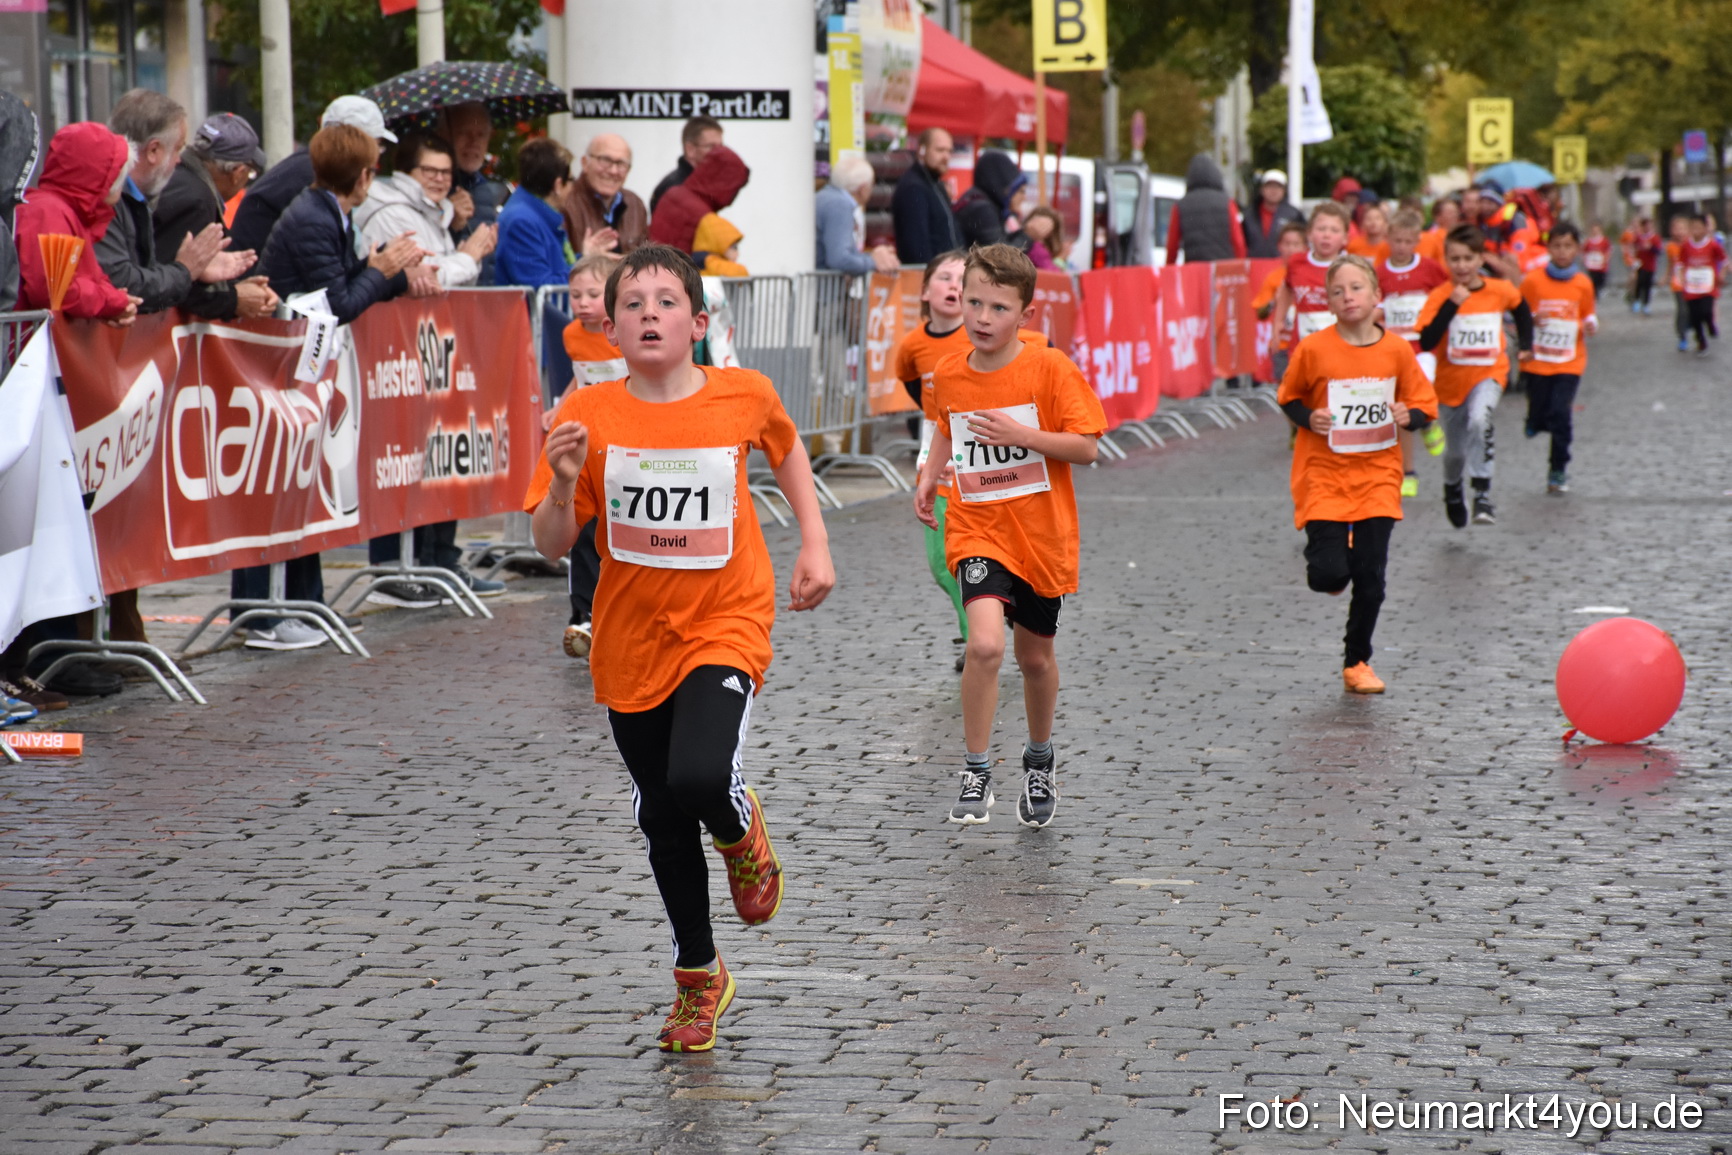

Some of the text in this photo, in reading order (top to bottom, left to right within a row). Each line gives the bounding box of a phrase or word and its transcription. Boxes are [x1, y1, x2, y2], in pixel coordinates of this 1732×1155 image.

[1054, 0, 1086, 45] B
[574, 92, 783, 118] www.MINI-Partl.de
[1480, 119, 1500, 148] C
[1458, 330, 1493, 346] 7041
[1341, 402, 1388, 426] 7268
[112, 391, 156, 480] NEUE
[653, 460, 698, 471] BOCK
[964, 440, 1028, 467] 7103
[980, 472, 1019, 486] Dominik
[623, 486, 709, 521] 7071
[650, 535, 687, 548] David
